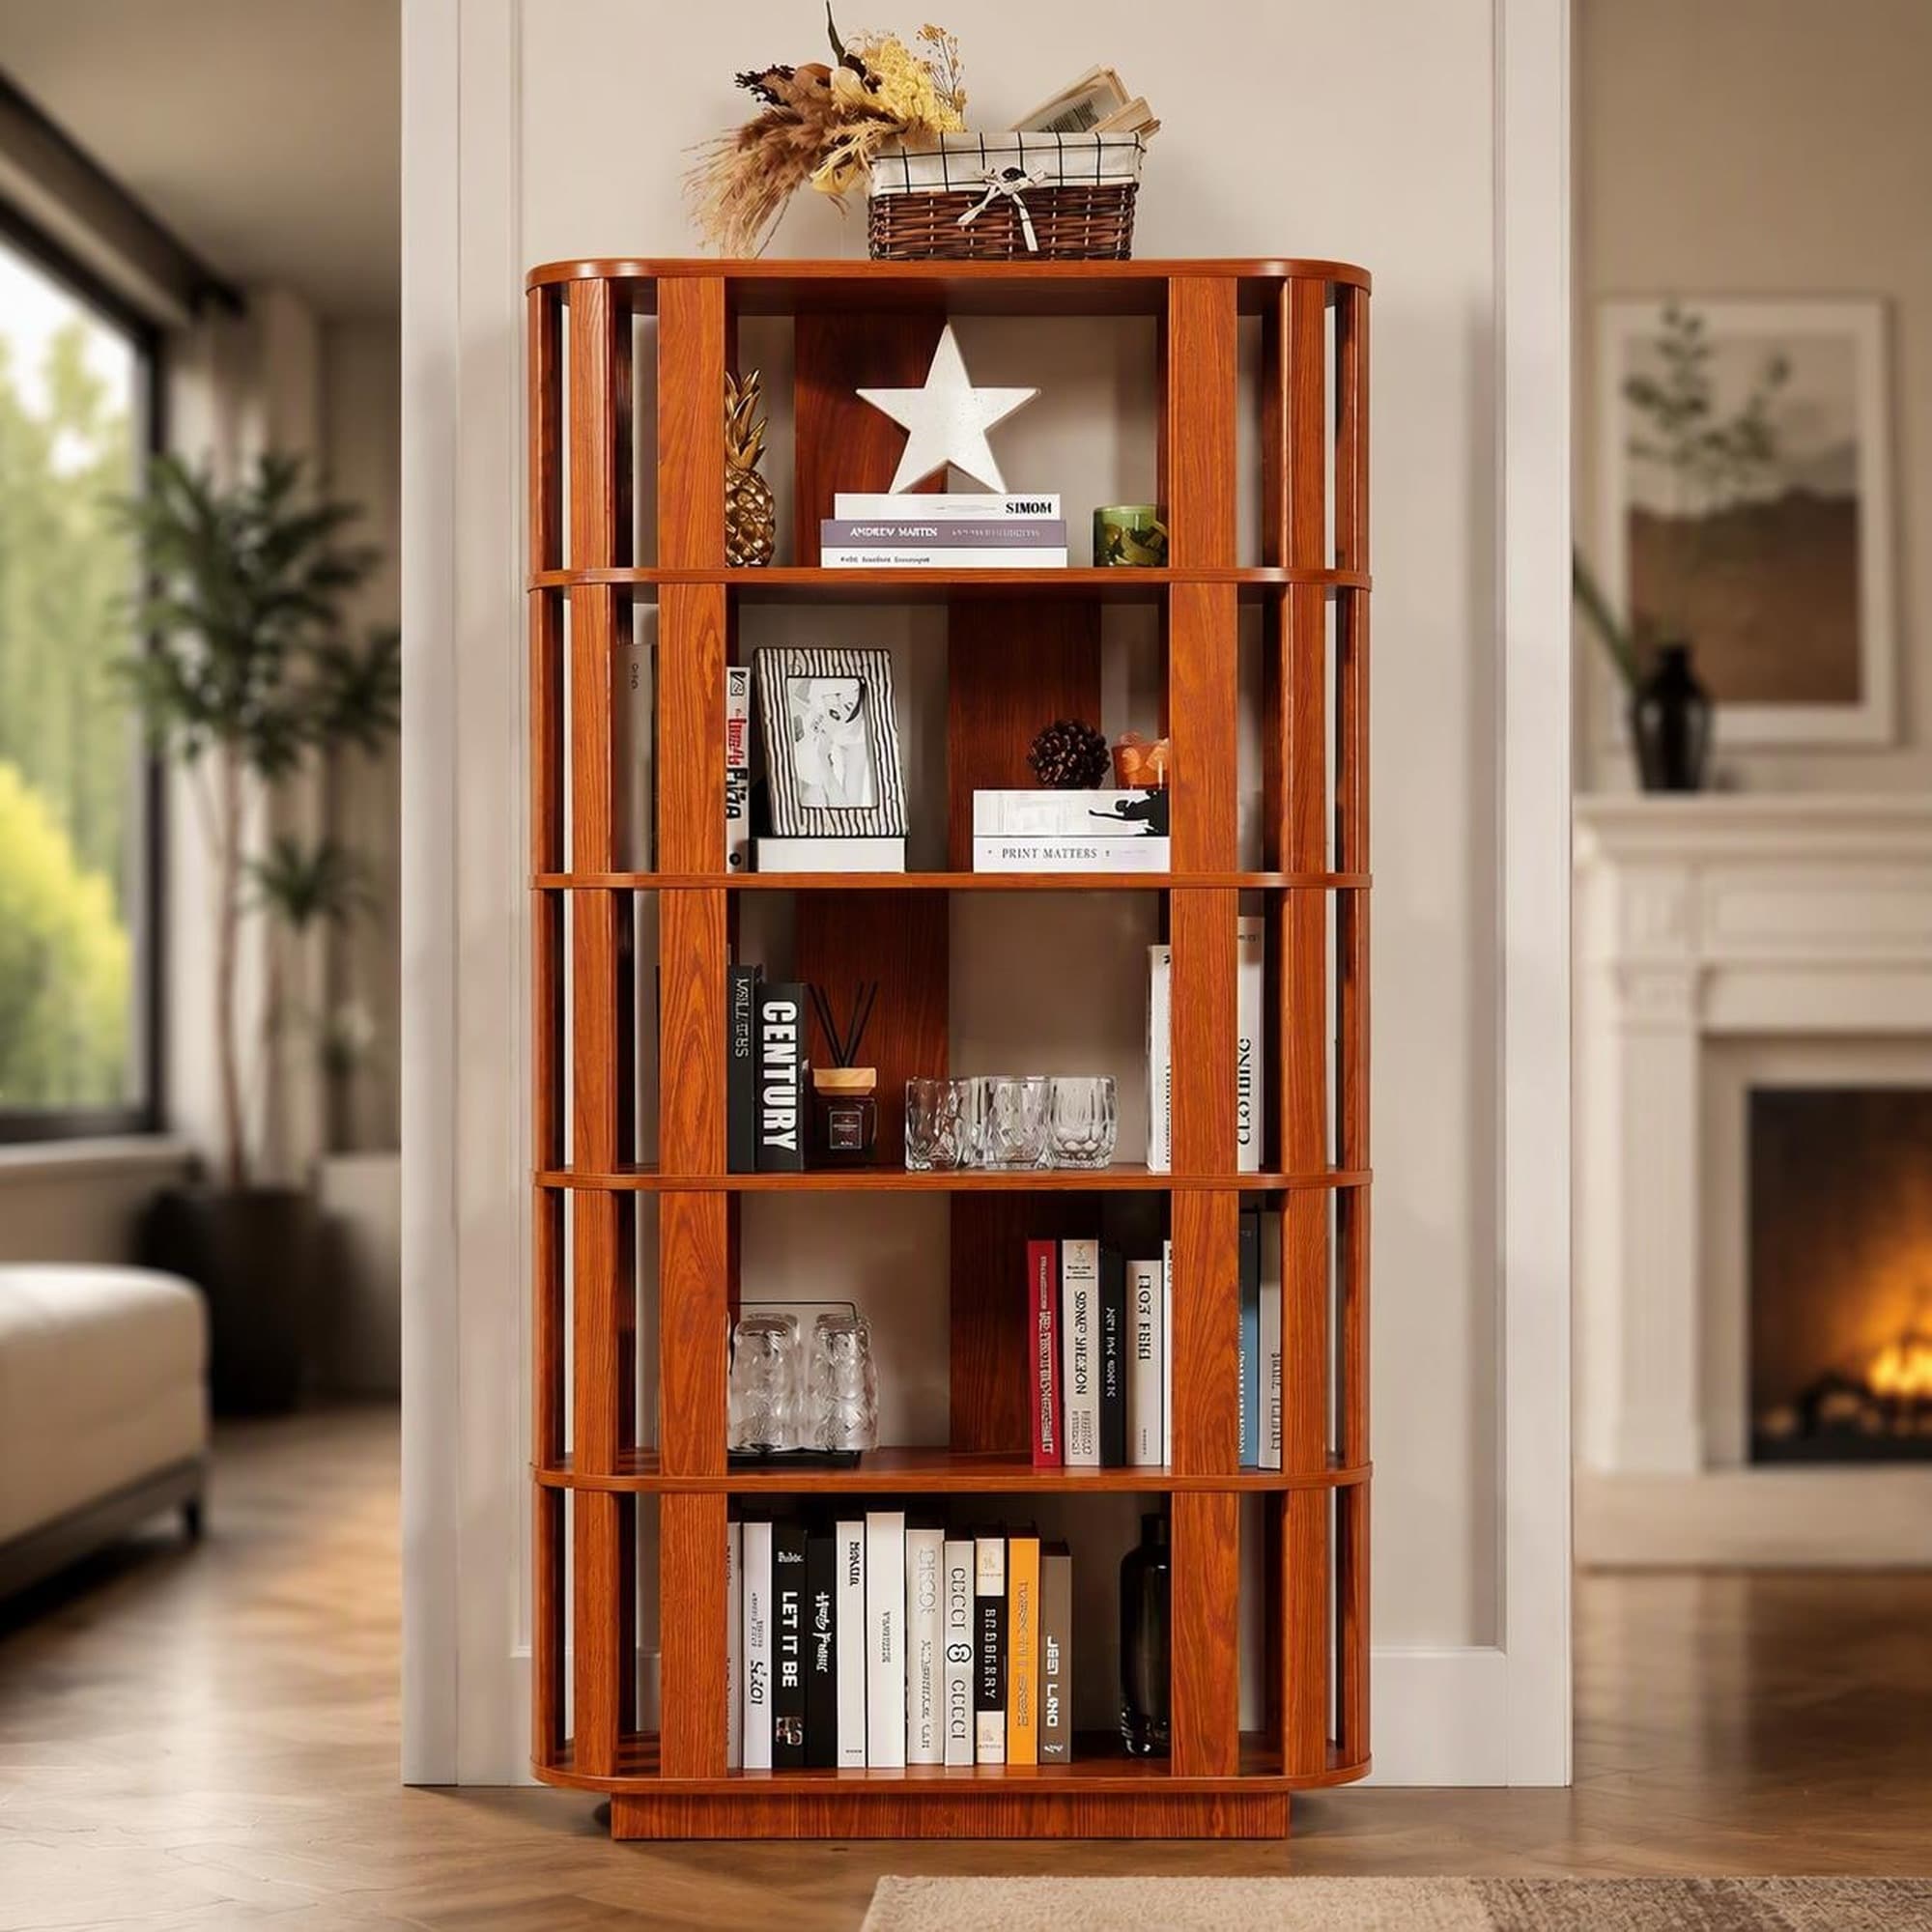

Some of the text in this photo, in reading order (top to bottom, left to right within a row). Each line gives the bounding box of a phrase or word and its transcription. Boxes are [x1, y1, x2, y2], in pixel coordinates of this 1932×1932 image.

[1002, 847, 1038, 859] PRINT
[762, 1001, 797, 1151] CENTURY
[781, 1591, 798, 1688] LET IT BE
